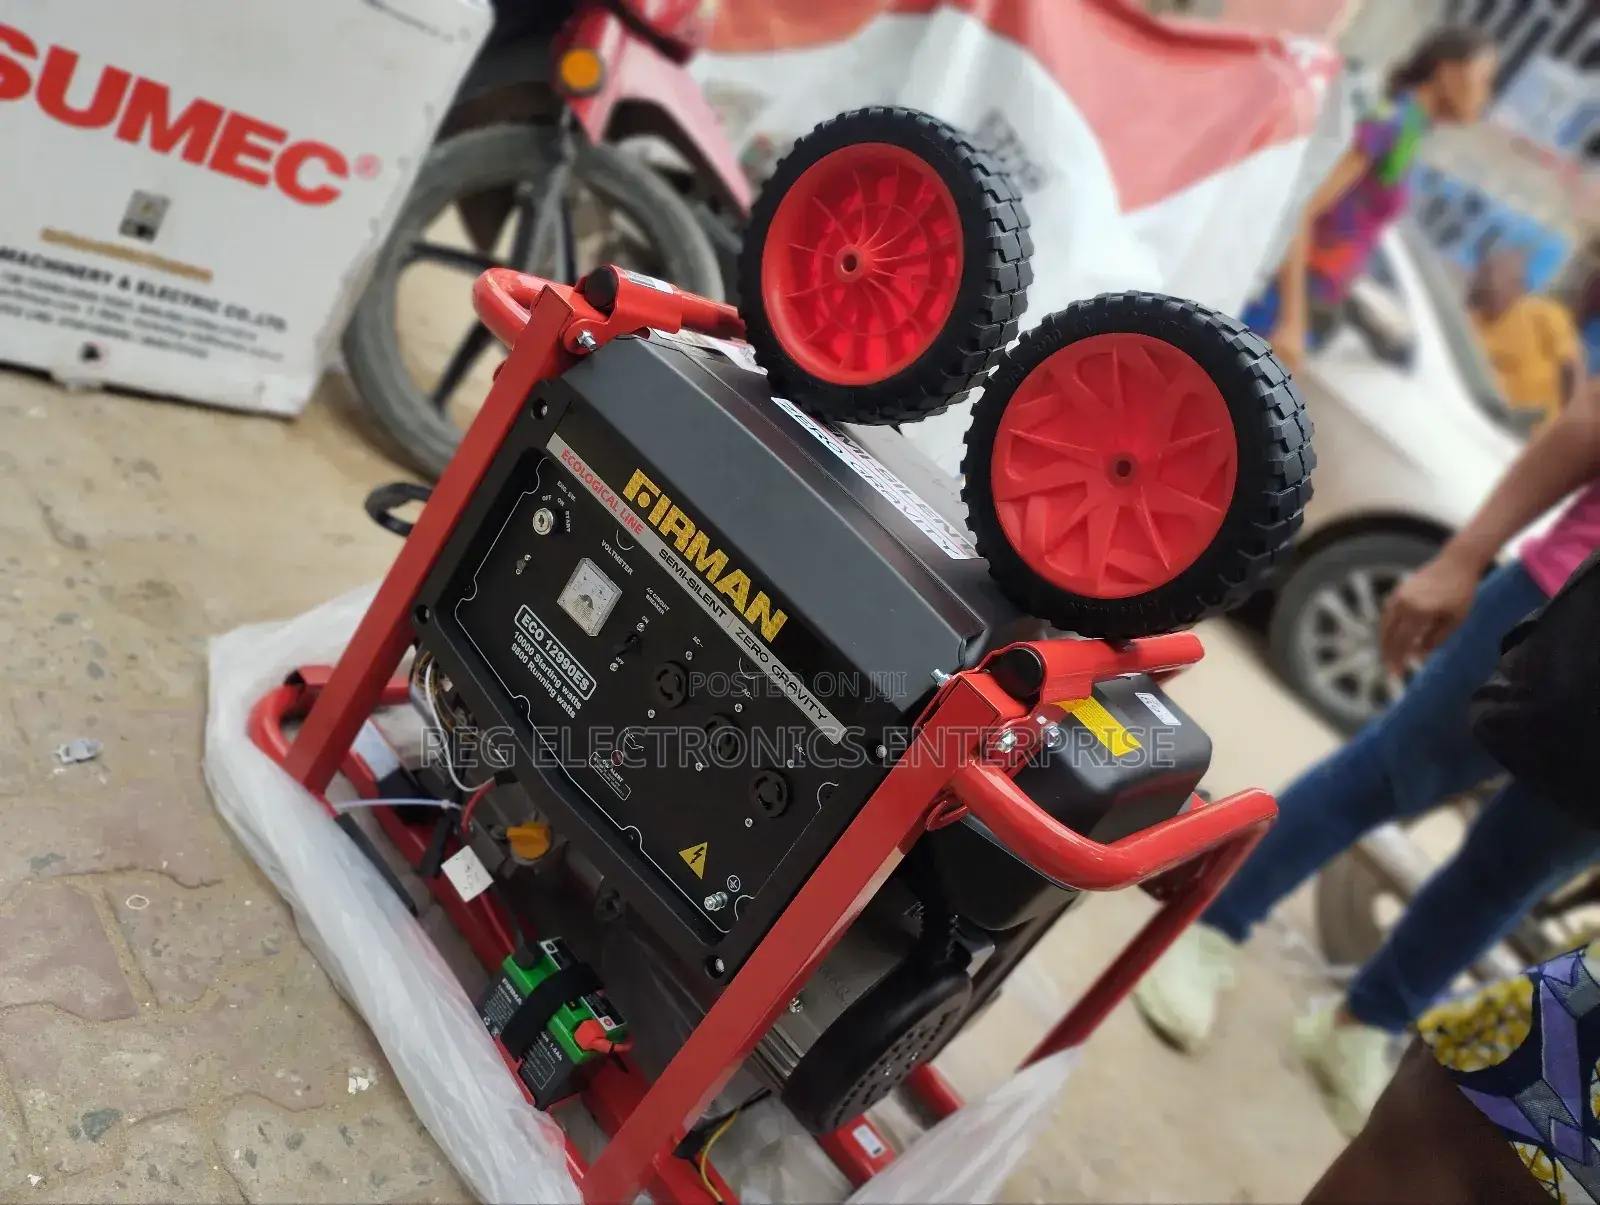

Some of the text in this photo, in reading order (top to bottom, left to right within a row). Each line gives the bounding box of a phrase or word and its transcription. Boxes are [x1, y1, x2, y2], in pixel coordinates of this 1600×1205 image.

[0, 23, 349, 206] SUMEC
[561, 449, 644, 535] ECOLOGICAL LINE
[778, 401, 960, 556] ZERO GRAVITY
[601, 540, 634, 576] VOLTMETER
[622, 468, 788, 643] FIRMAN
[514, 631, 582, 709] 10000 Starting watts
[521, 613, 590, 691] ECO 12990ES
[658, 548, 827, 720] SEMI-SILENT ZERO GRAVITY
[511, 643, 576, 718] 9800 Running watts
